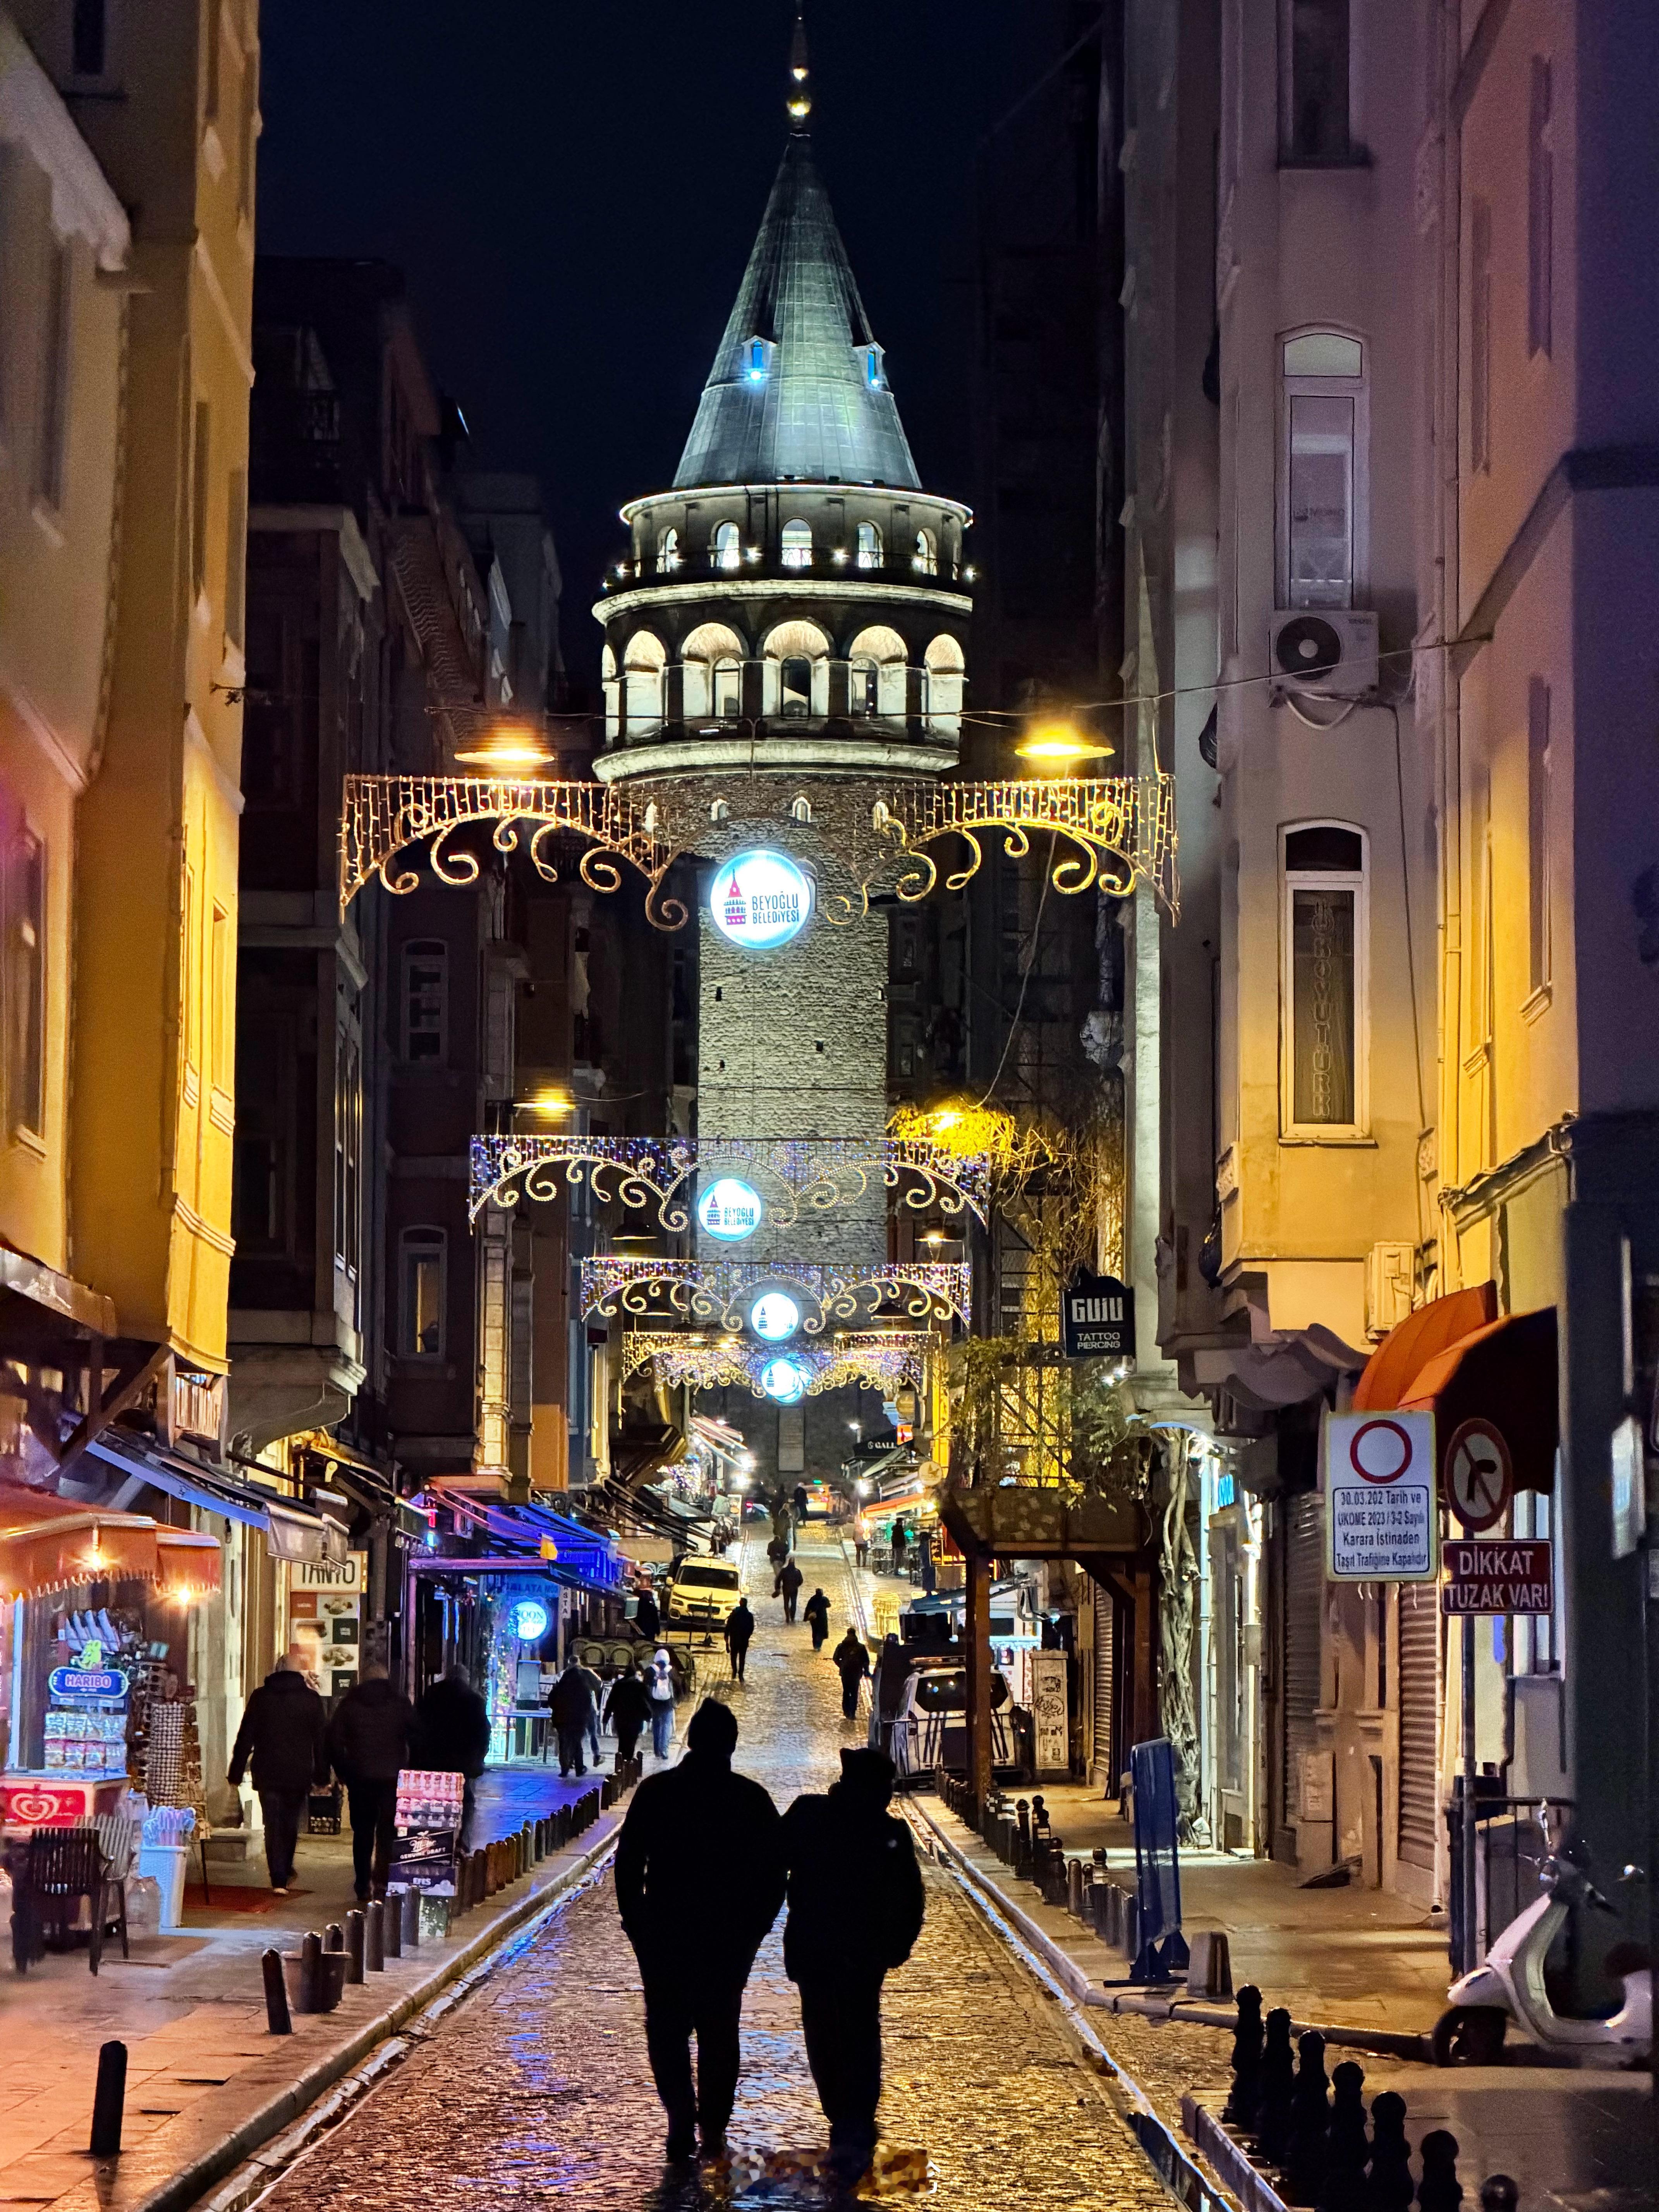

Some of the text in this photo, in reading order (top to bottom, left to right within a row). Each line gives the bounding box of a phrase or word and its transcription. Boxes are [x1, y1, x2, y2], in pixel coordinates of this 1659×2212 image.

[752, 891, 799, 910] BEYOĞLU
[753, 909, 799, 924] BELEDİYESİ
[1077, 1332, 1120, 1341] TATTOO
[1077, 1341, 1121, 1350] PIERCING
[1386, 1490, 1408, 1504] Tarih
[1410, 1493, 1421, 1503] ve
[1343, 1528, 1420, 1546] Karara İstinaden
[1459, 1545, 1534, 1575] DİKKAT
[1444, 1584, 1505, 1608] TUZAK
[65, 1674, 112, 1688] HARIBO
